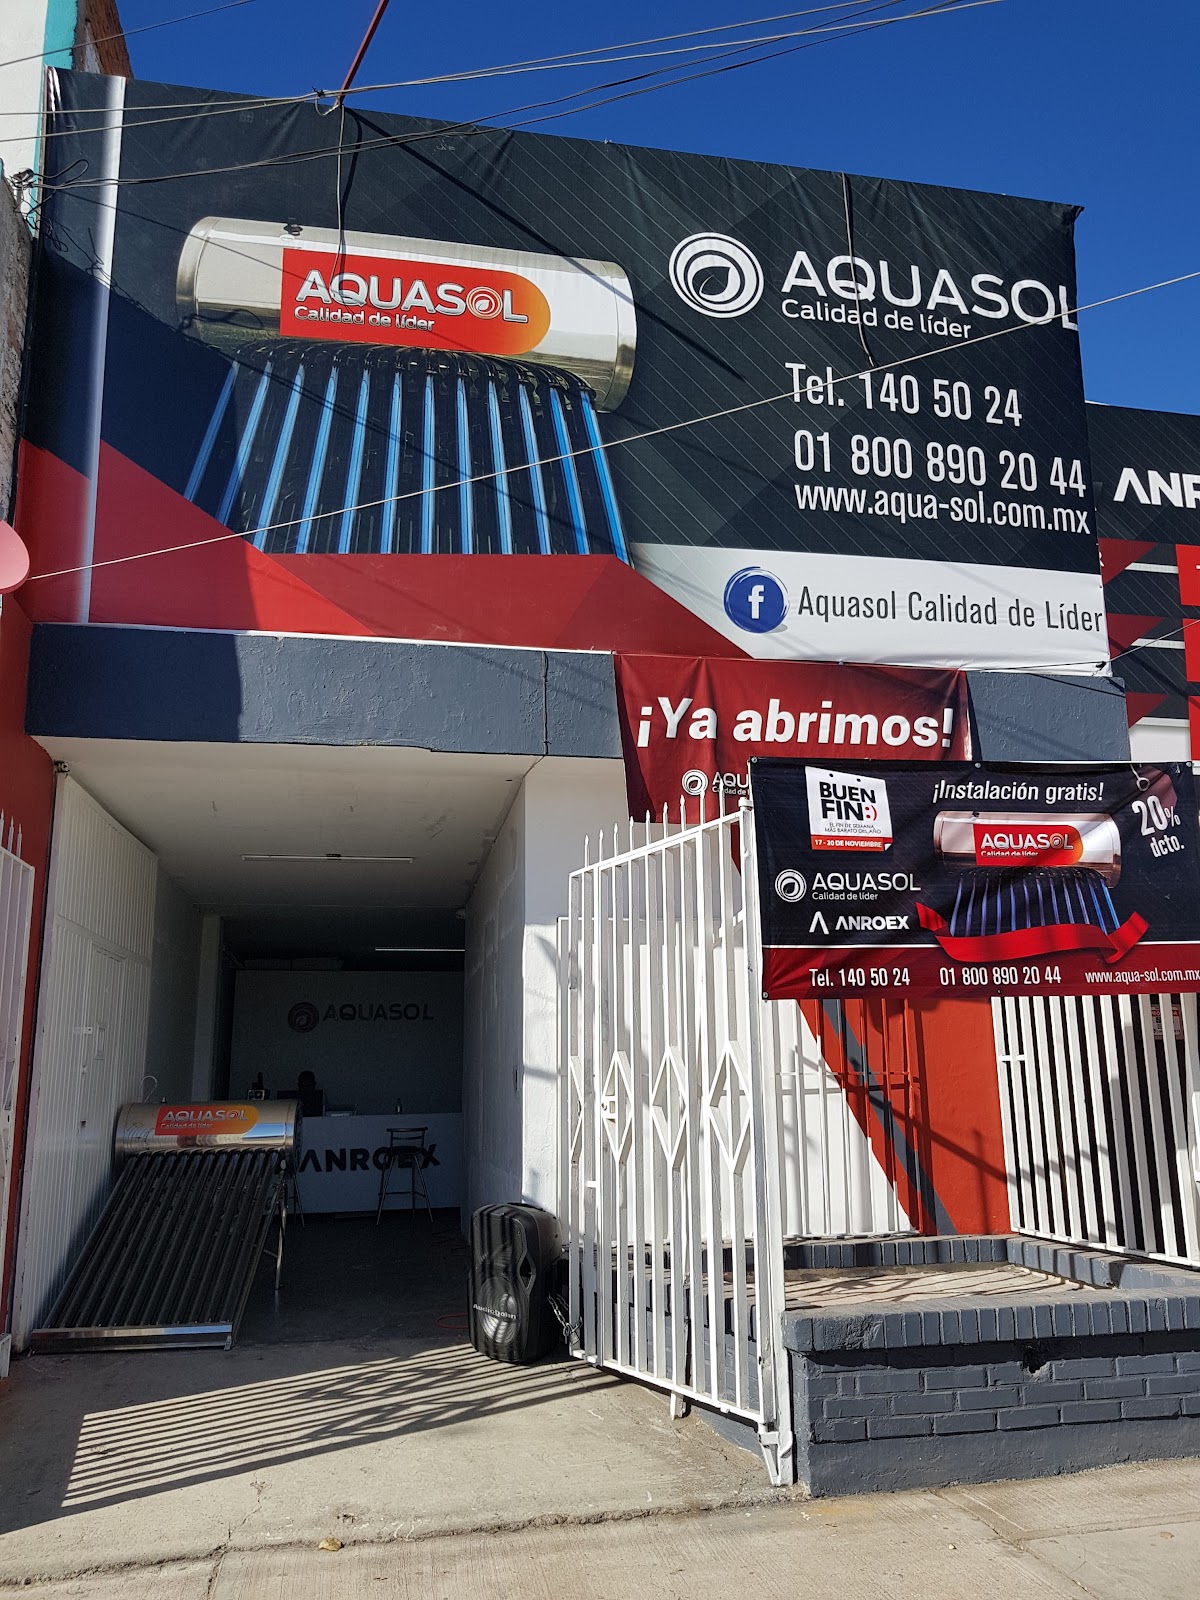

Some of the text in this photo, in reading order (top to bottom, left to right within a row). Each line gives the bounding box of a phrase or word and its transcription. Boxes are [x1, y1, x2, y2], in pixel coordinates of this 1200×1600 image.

[296, 269, 528, 324] AQUASOL
[781, 251, 1079, 331] AQUASOL
[294, 306, 435, 332] Calidad de líder
[782, 299, 972, 338] Calidad de líder
[785, 362, 1023, 427] Tel. 140 50 24
[794, 430, 1087, 498] 01 800 890 20 44
[795, 484, 1090, 535] www.aqua-sol.com.mx
[798, 586, 1103, 633] Aquasol Calidad de Líder
[637, 697, 954, 748] ¡Ya abrimos!
[819, 782, 876, 804] BUEN
[932, 779, 1104, 805] ¡Instalación gratis!
[1131, 795, 1181, 837] 20%
[845, 840, 882, 848] NOVIEMBRE
[980, 833, 1074, 850] AQUASOL
[1149, 834, 1185, 858] dcto.
[812, 872, 922, 891] AQUASOL
[812, 891, 879, 901] Calidad de líder
[835, 915, 910, 931] ANROEX
[809, 965, 1200, 987] Tel. 140 50 24 01 800 890 20 44 www.aqua-sol.com.mx
[323, 1003, 434, 1022] AQUASOL
[162, 1109, 248, 1122] AQUASOL
